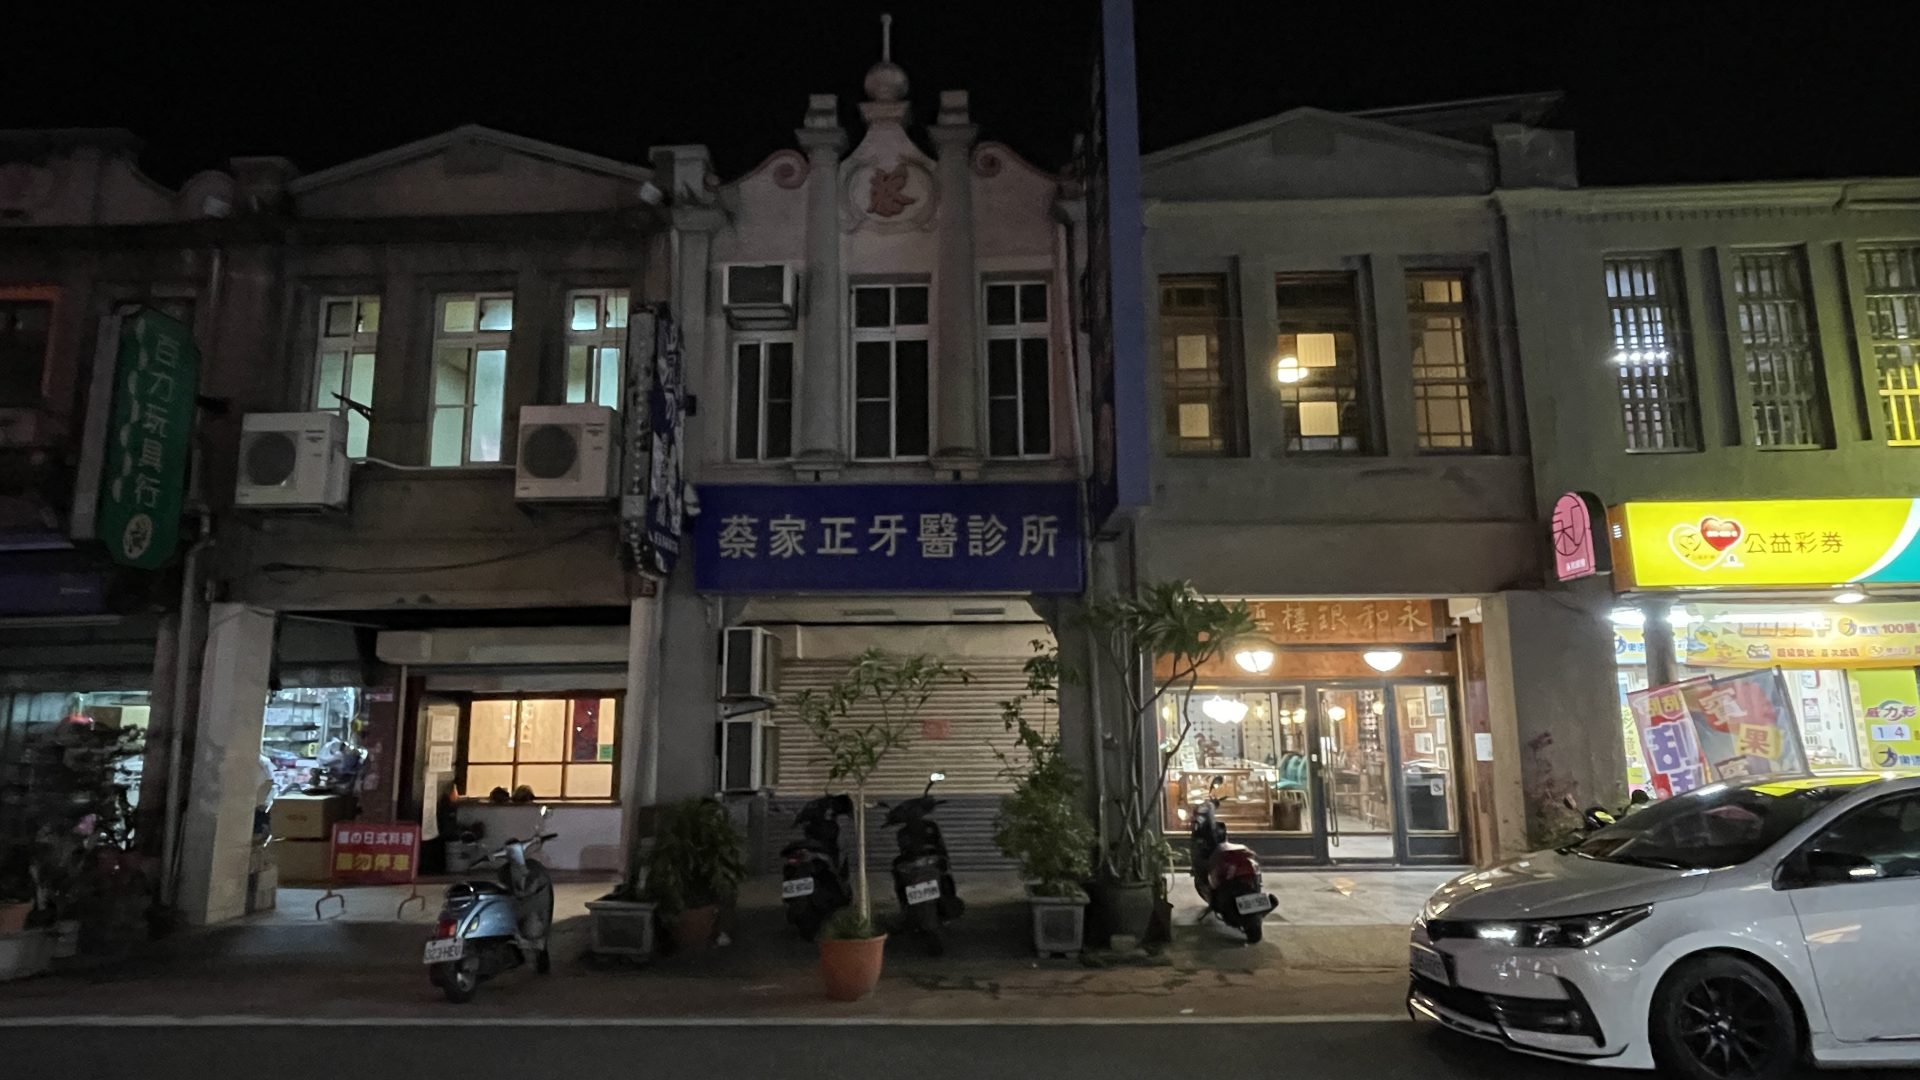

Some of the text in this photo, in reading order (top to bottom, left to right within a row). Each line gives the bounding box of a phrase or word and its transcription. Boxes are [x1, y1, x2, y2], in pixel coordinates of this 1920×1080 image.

[134, 333, 181, 508] 百力玩具行
[718, 512, 1059, 559] 蔡家正牙醫診所
[1744, 531, 1844, 555] 公益彩券
